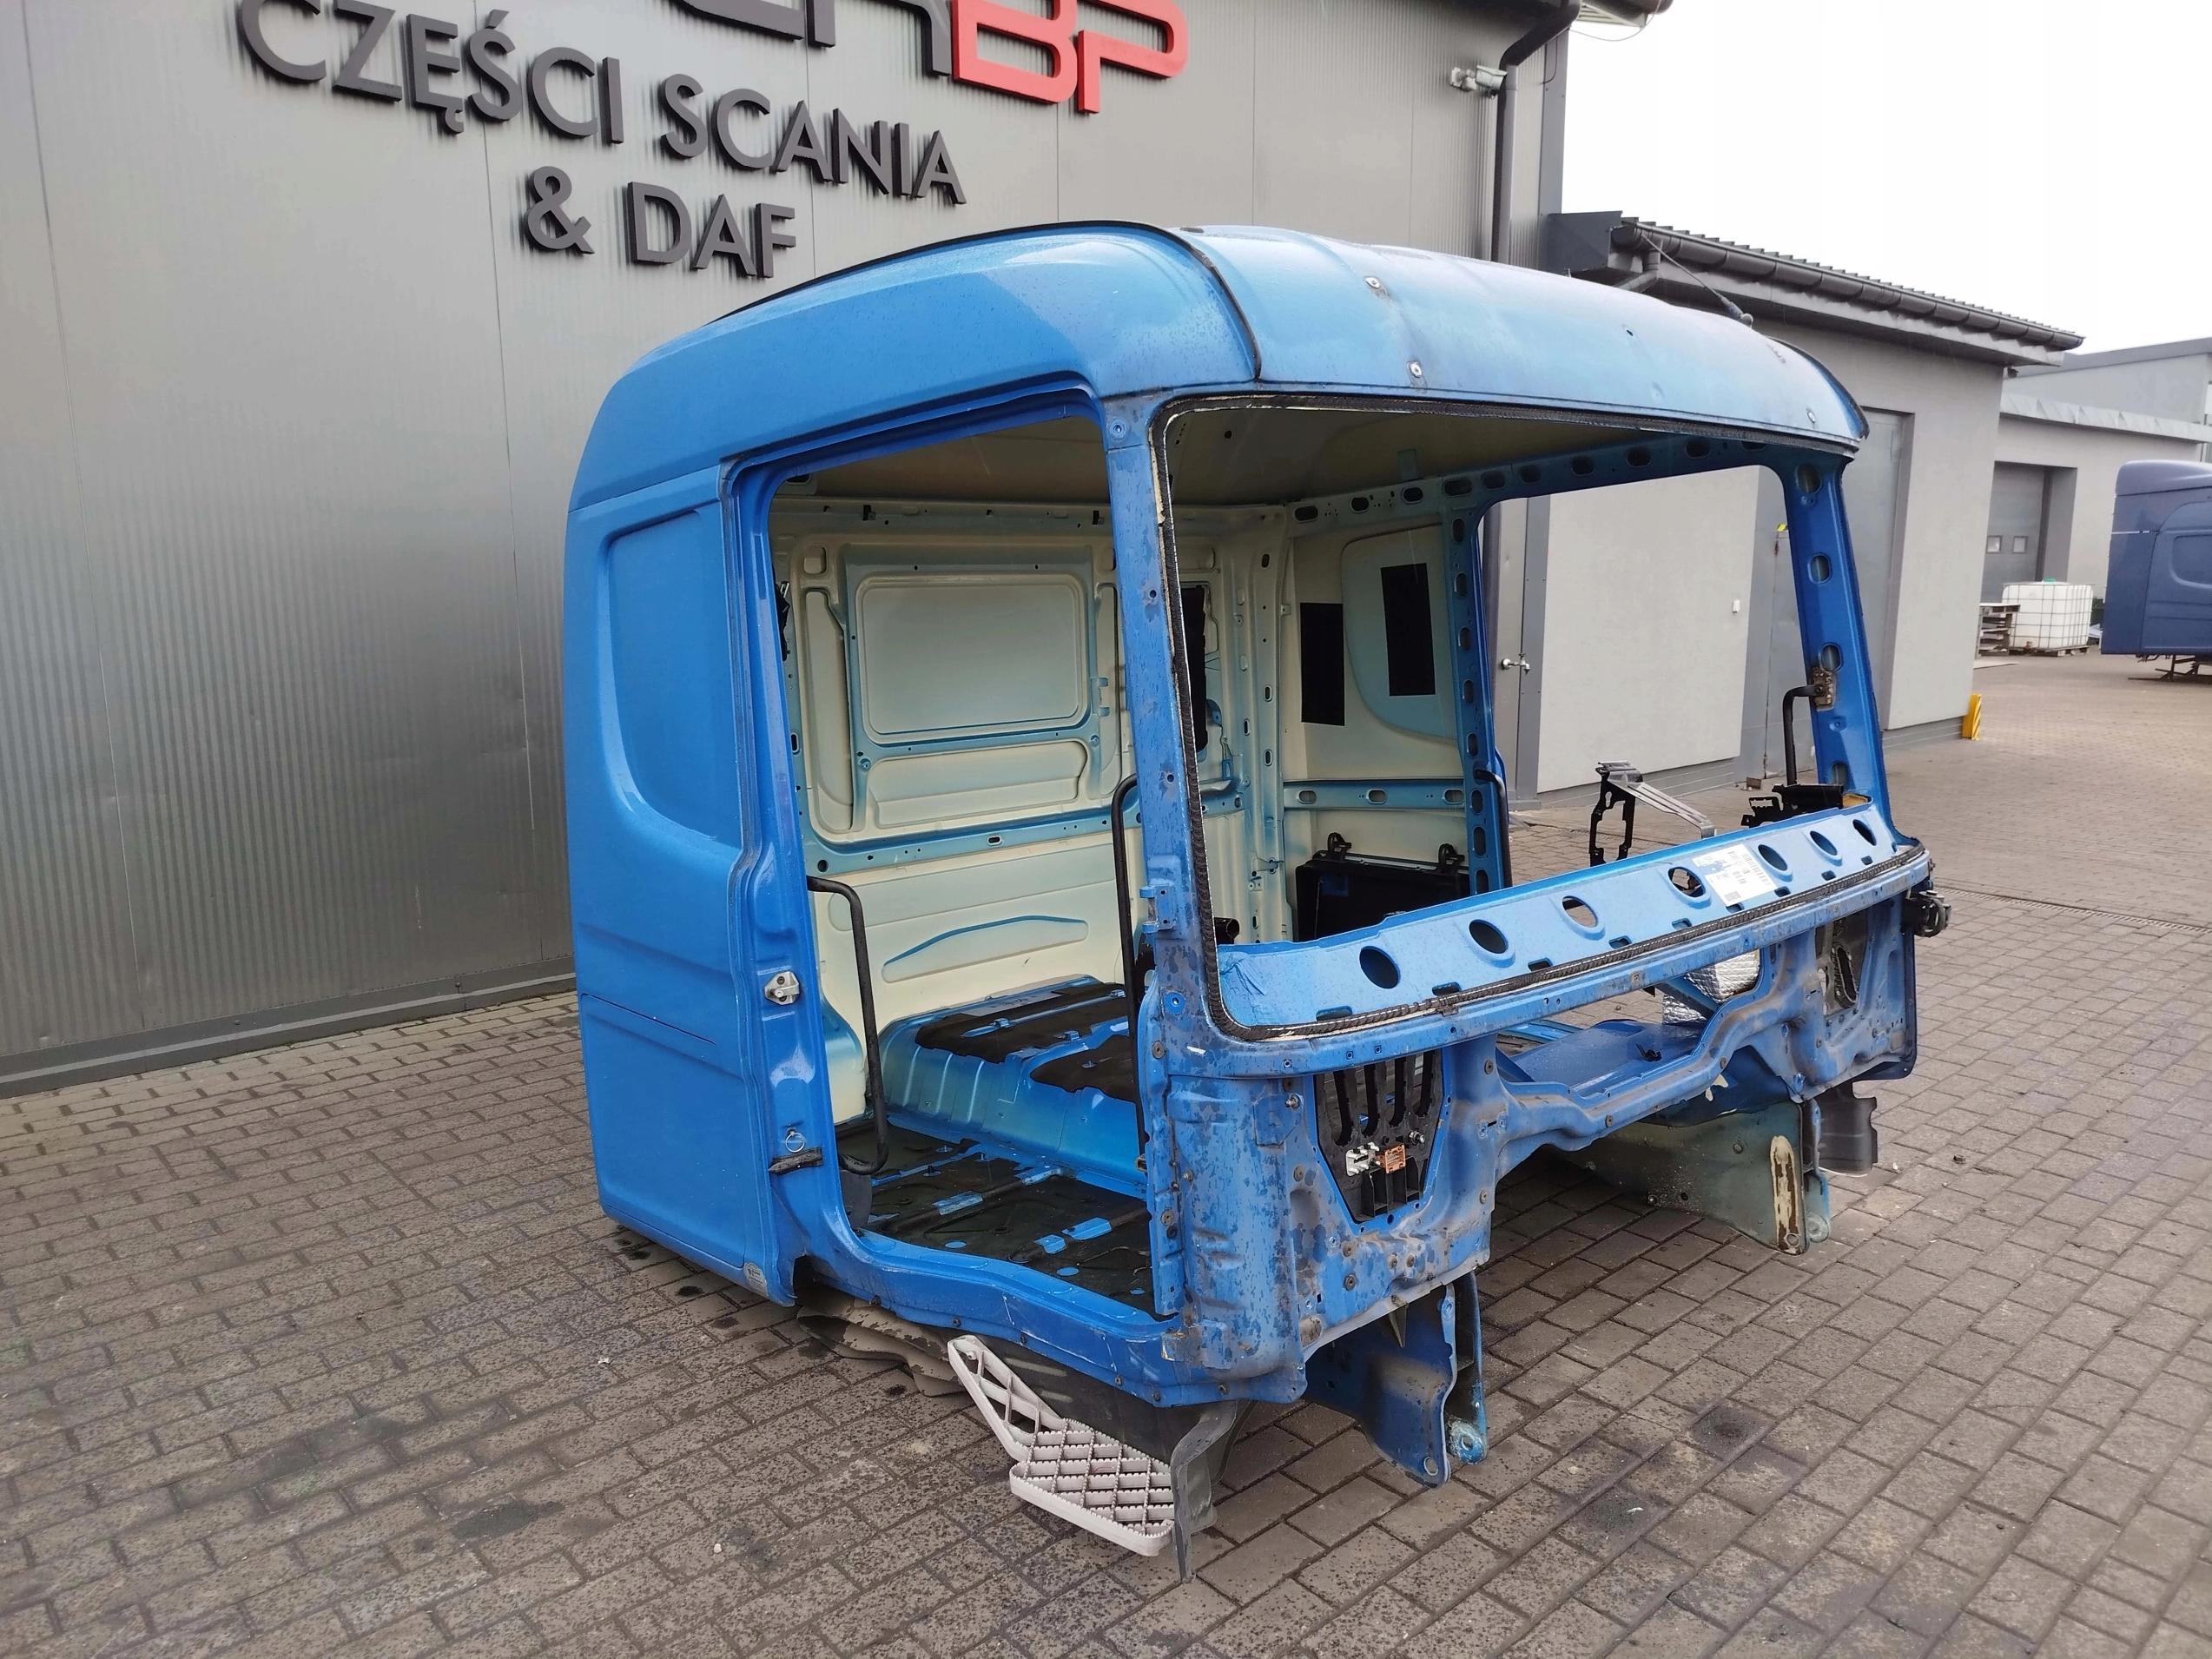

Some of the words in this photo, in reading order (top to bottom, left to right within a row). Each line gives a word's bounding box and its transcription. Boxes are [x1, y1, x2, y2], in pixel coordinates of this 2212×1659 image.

[237, 0, 624, 144] CZĘŚCI
[659, 74, 967, 205] SCANIA
[525, 166, 595, 254] &
[625, 182, 796, 278] DAF
